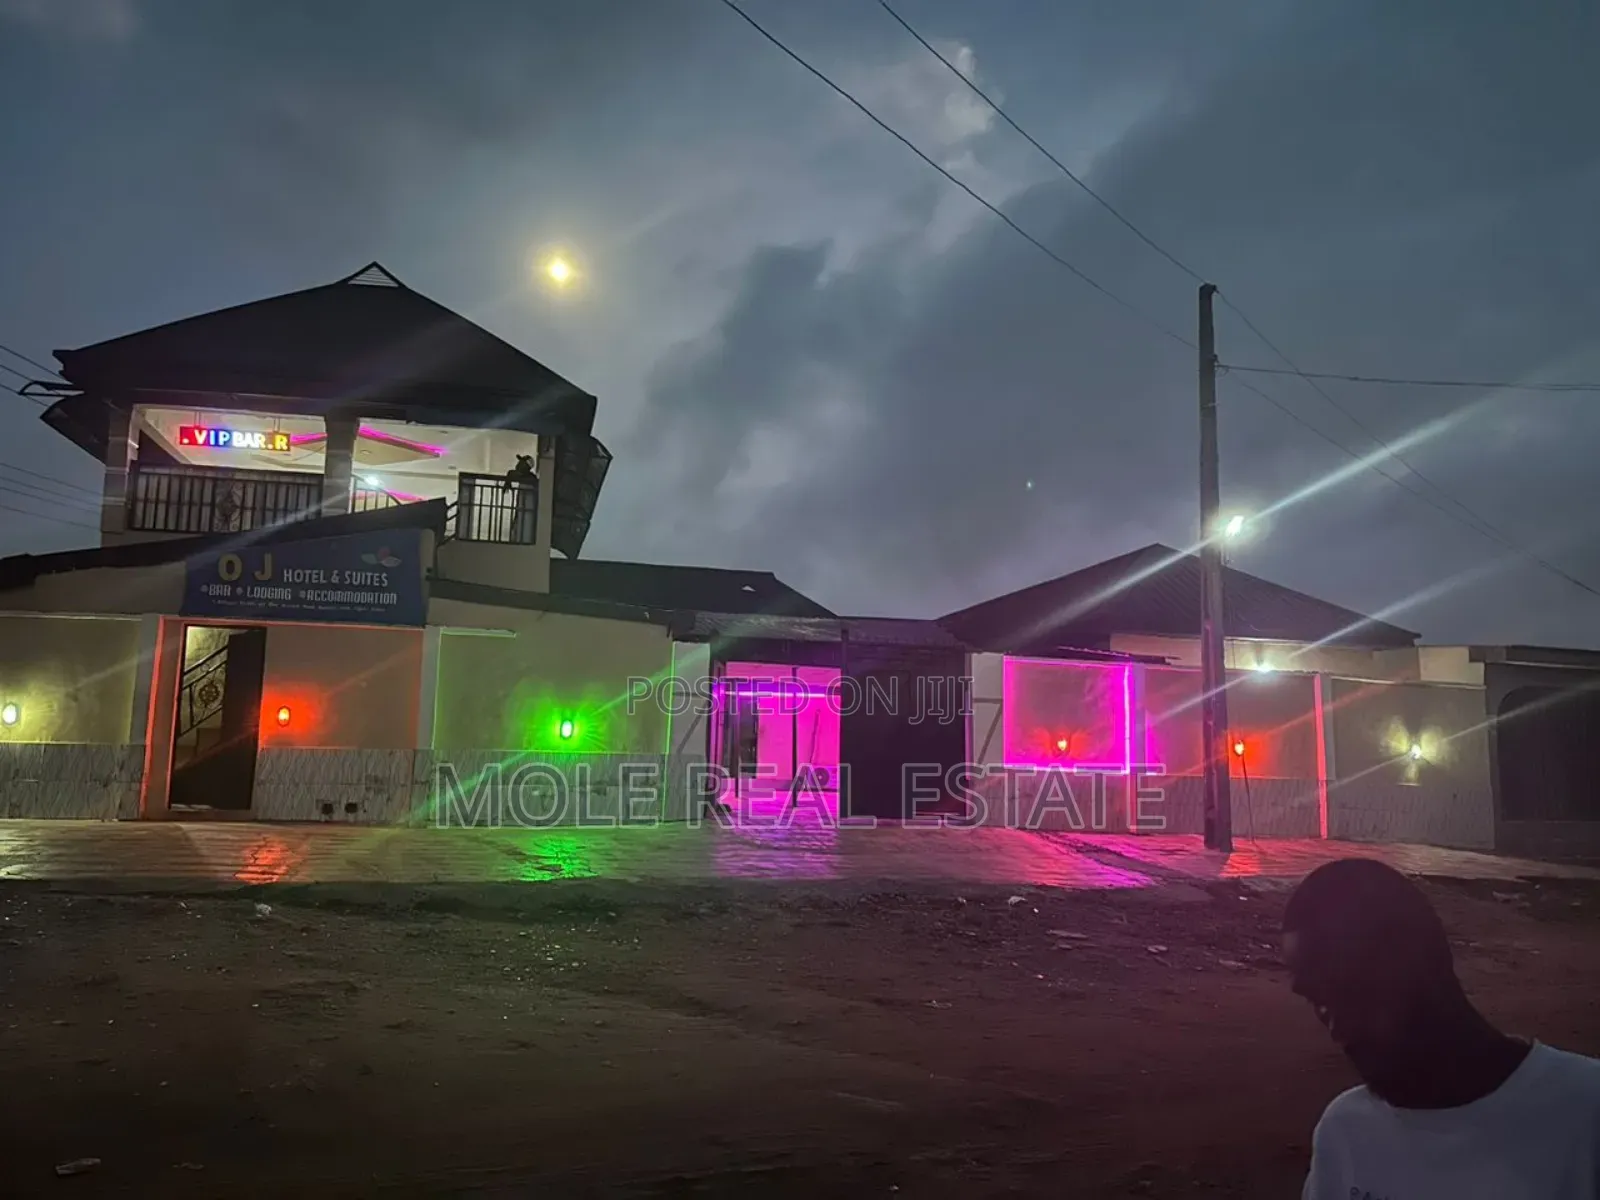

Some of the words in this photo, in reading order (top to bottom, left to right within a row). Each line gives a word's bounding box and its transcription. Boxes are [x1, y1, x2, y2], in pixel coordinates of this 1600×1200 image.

[218, 553, 242, 581] O
[254, 553, 273, 581] J
[283, 568, 328, 584] HOTEL
[331, 571, 341, 584] &
[344, 570, 389, 587] SUITES
[208, 584, 232, 596] BAR
[246, 585, 292, 600] LODGING
[306, 589, 398, 605] ACCOMMODATION
